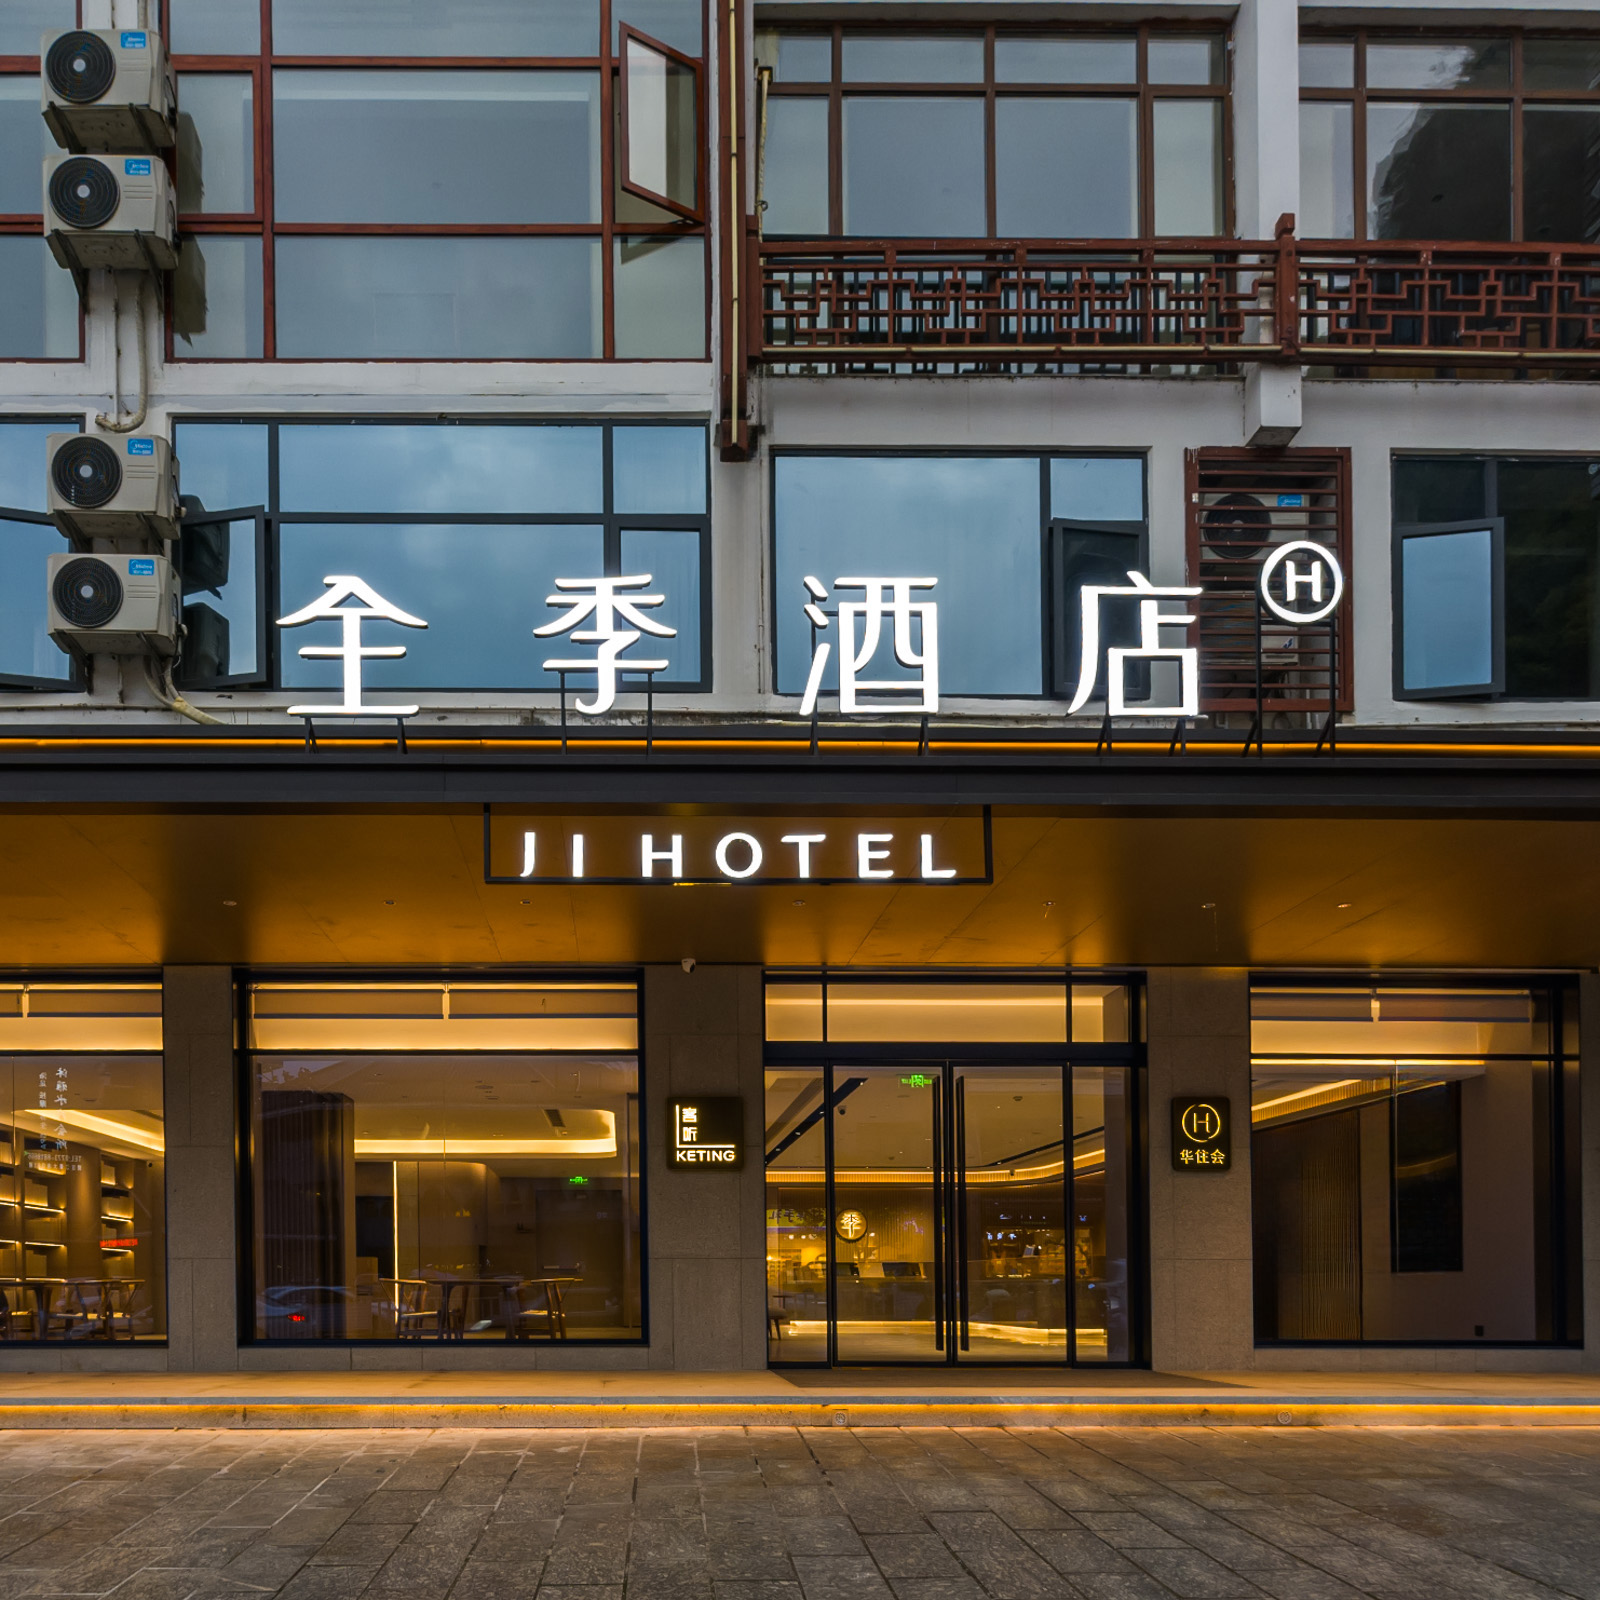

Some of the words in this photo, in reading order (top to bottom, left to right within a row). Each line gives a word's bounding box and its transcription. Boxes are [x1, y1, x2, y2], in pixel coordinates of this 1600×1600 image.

[276, 571, 1204, 717] 全季酒店
[520, 831, 584, 879] JI
[641, 831, 958, 880] HOTEL
[676, 1150, 736, 1162] KETING
[1179, 1148, 1226, 1165] 华住会
